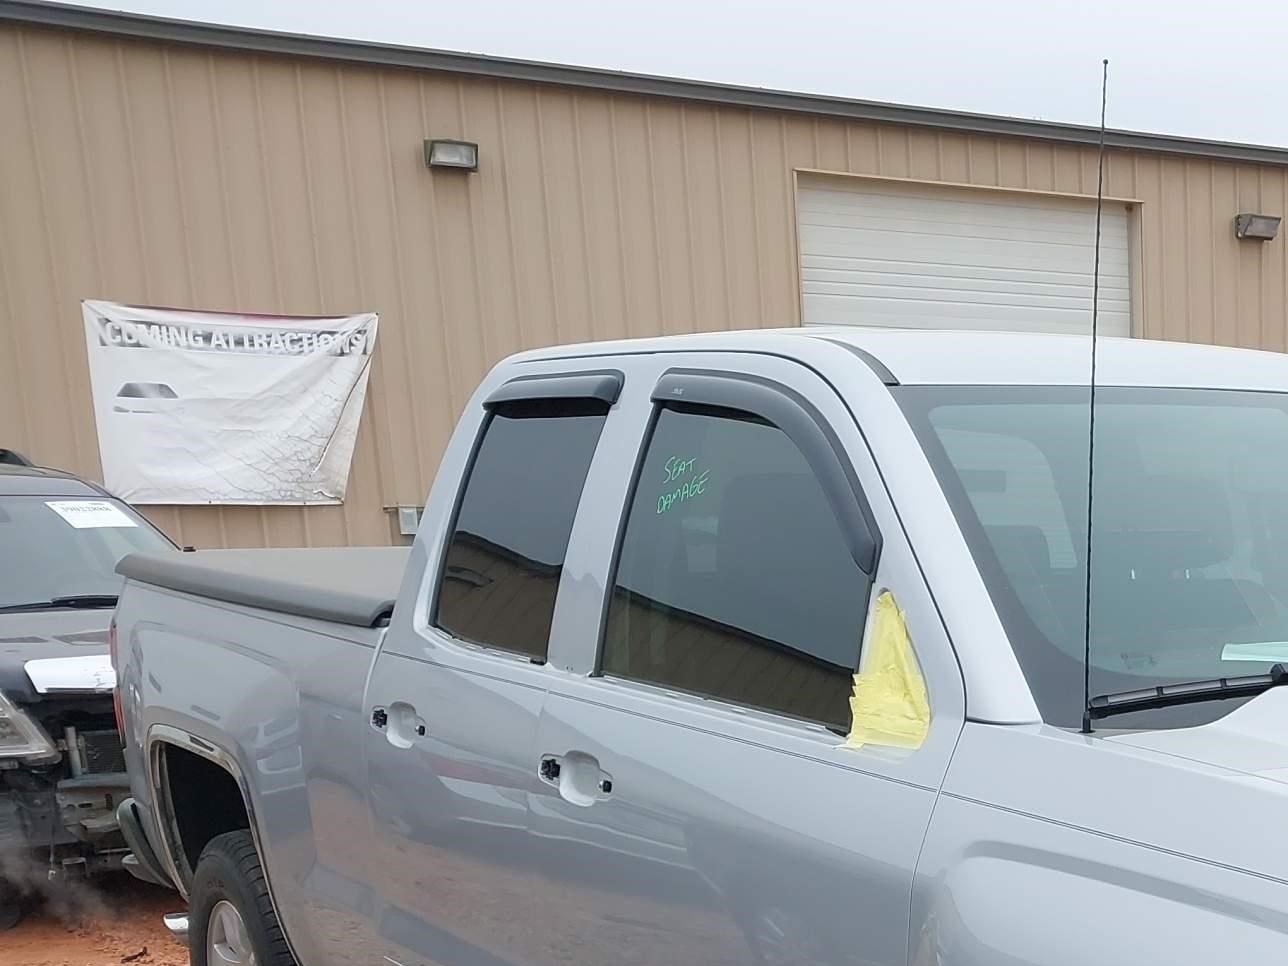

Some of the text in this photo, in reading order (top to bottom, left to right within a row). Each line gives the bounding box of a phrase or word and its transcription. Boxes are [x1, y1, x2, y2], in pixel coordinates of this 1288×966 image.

[105, 321, 367, 355] COMING ATTRACTIONS
[664, 455, 697, 483] SEAT
[656, 469, 711, 514] DAMAGE
